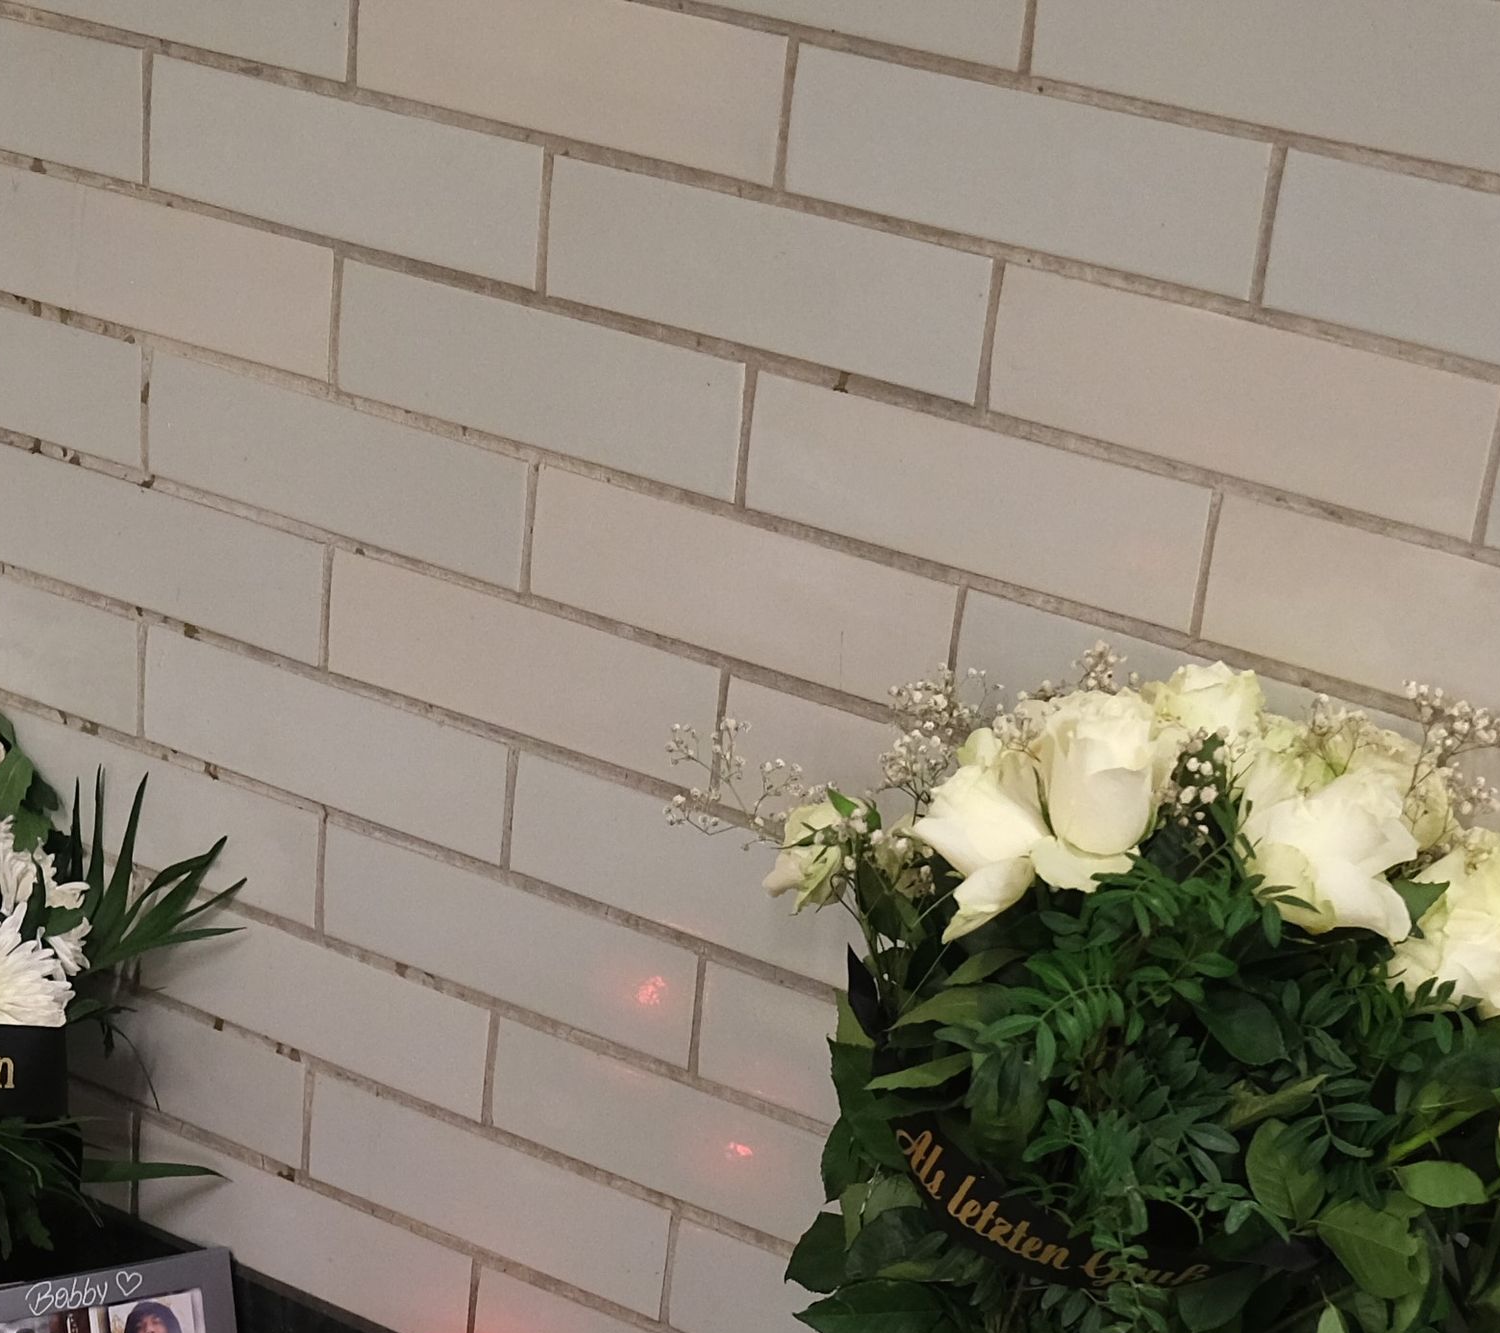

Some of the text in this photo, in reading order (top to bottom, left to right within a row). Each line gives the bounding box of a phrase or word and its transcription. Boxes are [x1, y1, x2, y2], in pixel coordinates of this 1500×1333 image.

[896, 1129, 1211, 1287] Als letzten Guß
[25, 1277, 108, 1316] Bobby
